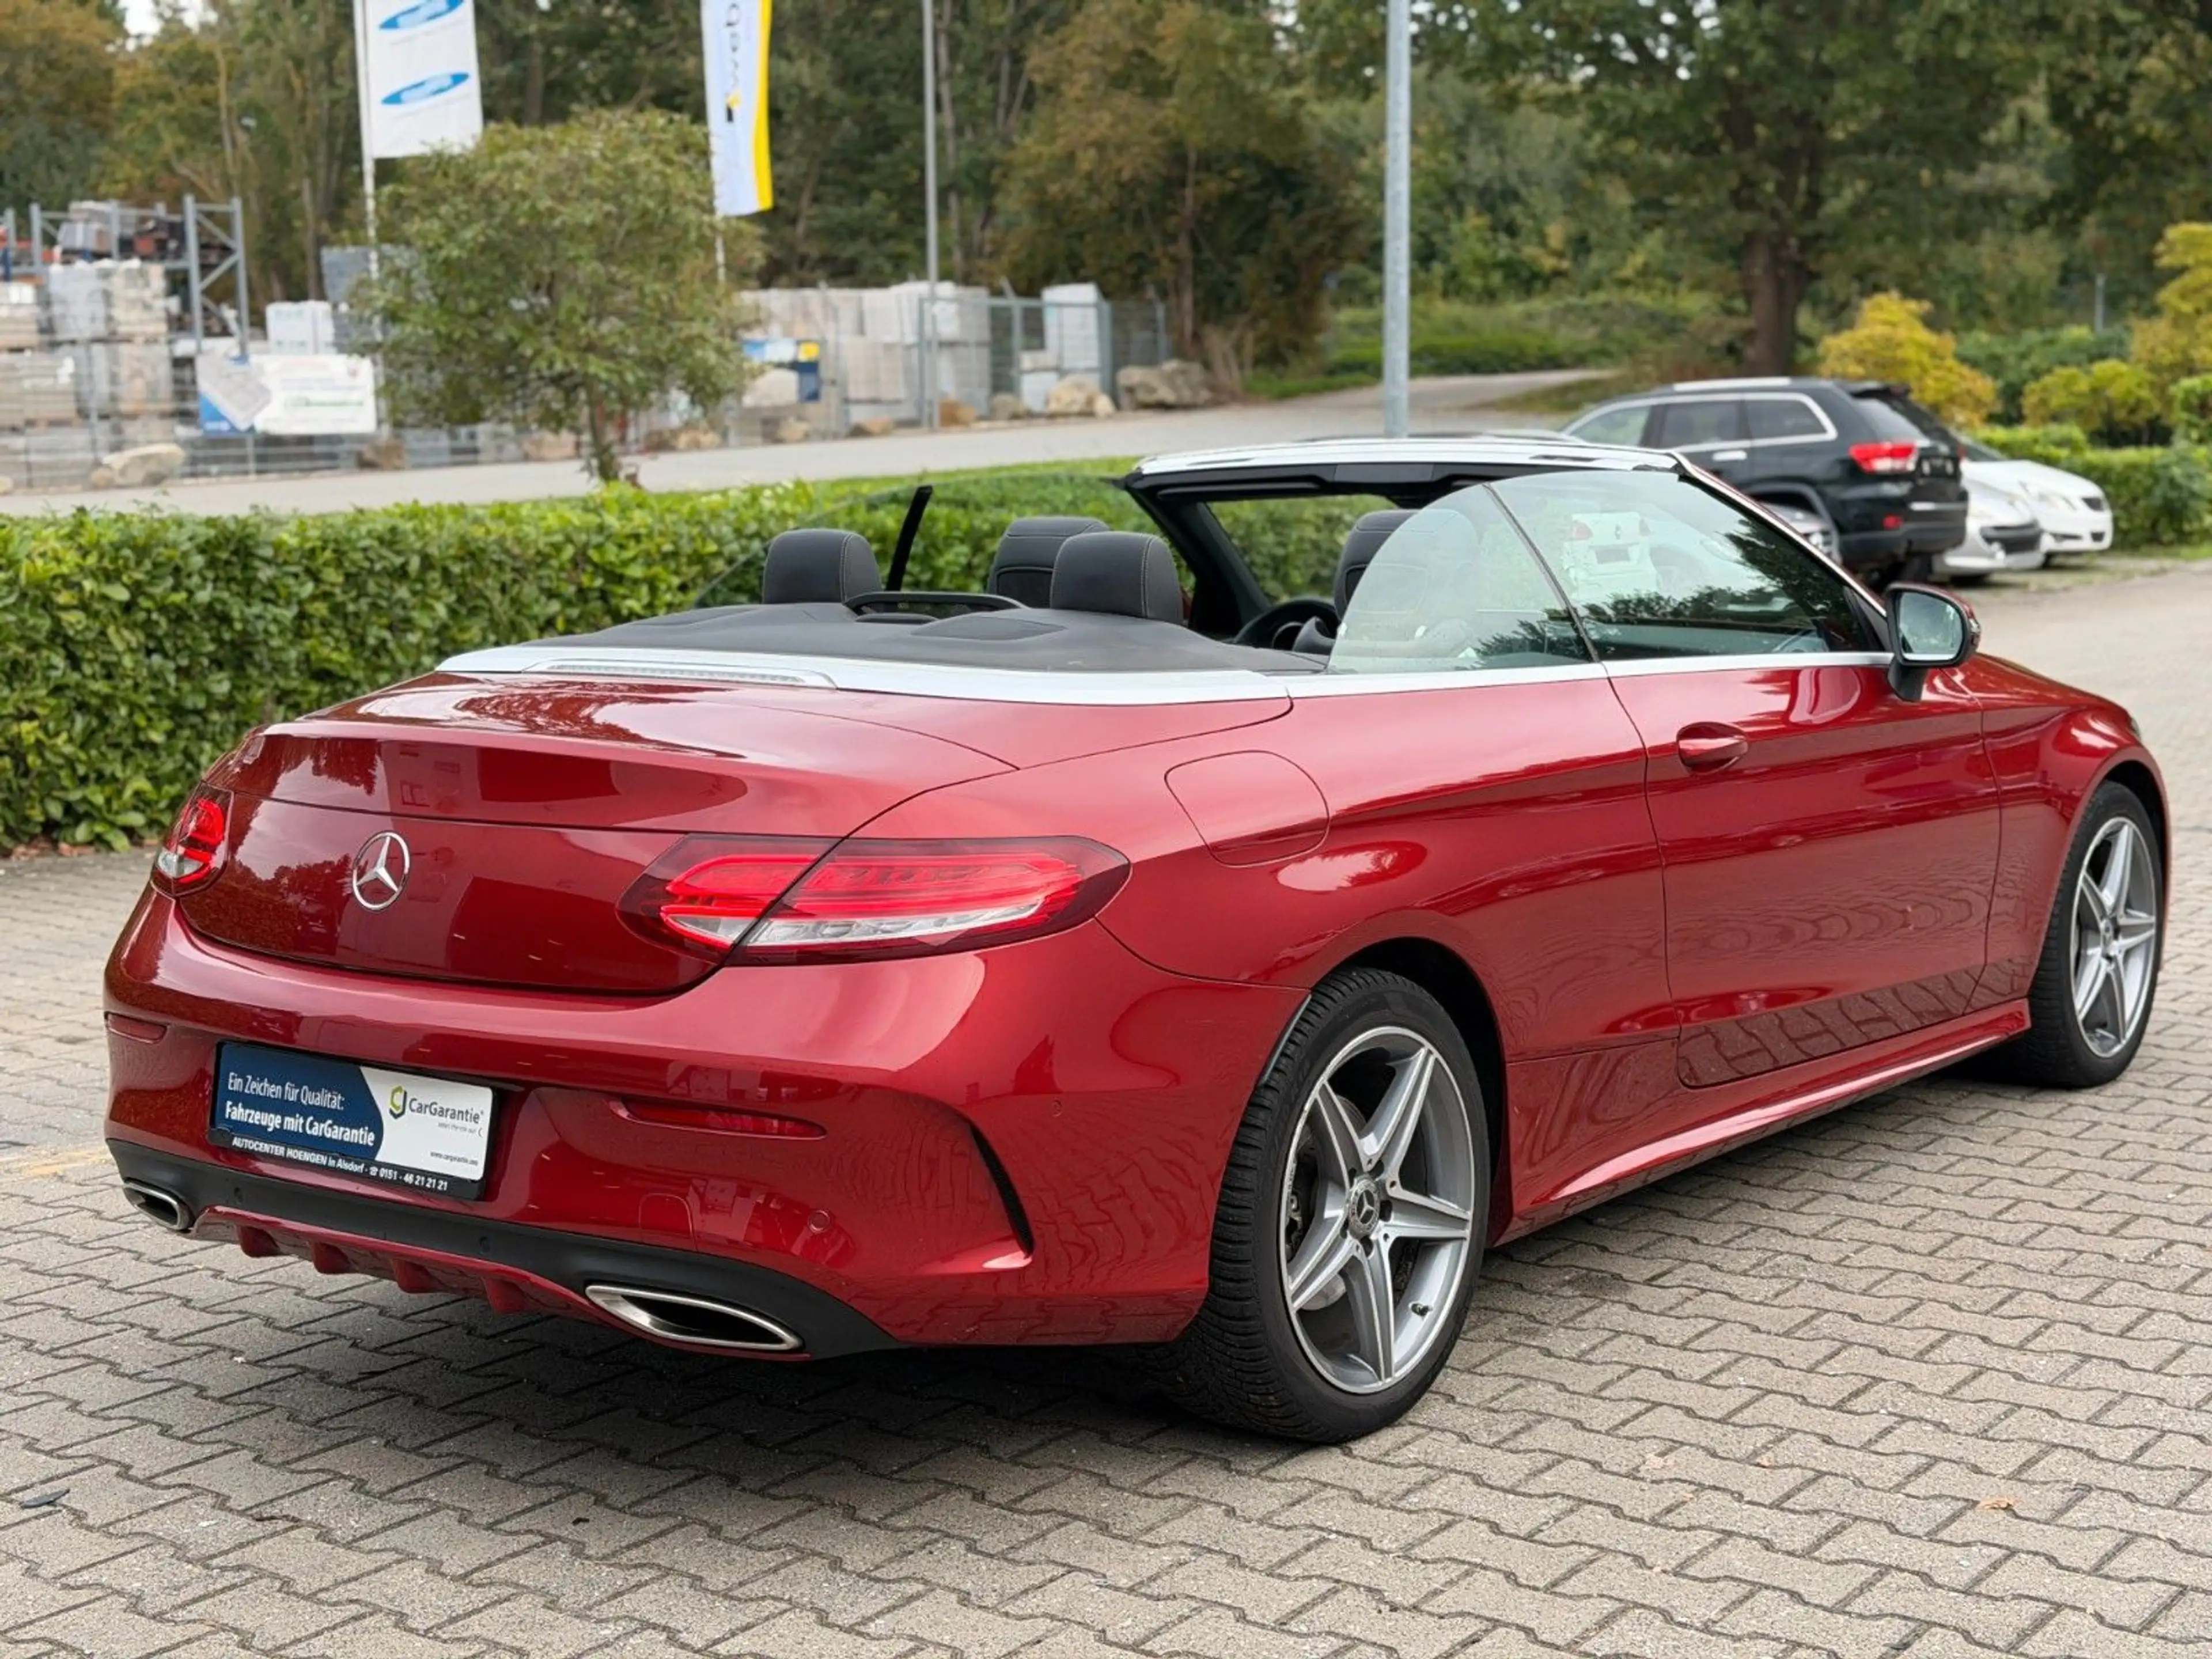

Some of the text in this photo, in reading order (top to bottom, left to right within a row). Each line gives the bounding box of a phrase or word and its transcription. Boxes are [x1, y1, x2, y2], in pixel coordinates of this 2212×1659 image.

[228, 1072, 345, 1111] Ein Zeichen für Qualität:
[409, 1097, 481, 1124] CarGarantie
[225, 1100, 376, 1147] Fahrzeuge mit CarGarantie
[232, 1136, 285, 1157] AUTOCENTER
[286, 1145, 327, 1166] HOENGEN
[336, 1158, 364, 1173] Alsdorf
[378, 1167, 397, 1180] 0151
[415, 1175, 425, 1187] 21
[426, 1177, 437, 1189] 21
[437, 1179, 448, 1191] 21
